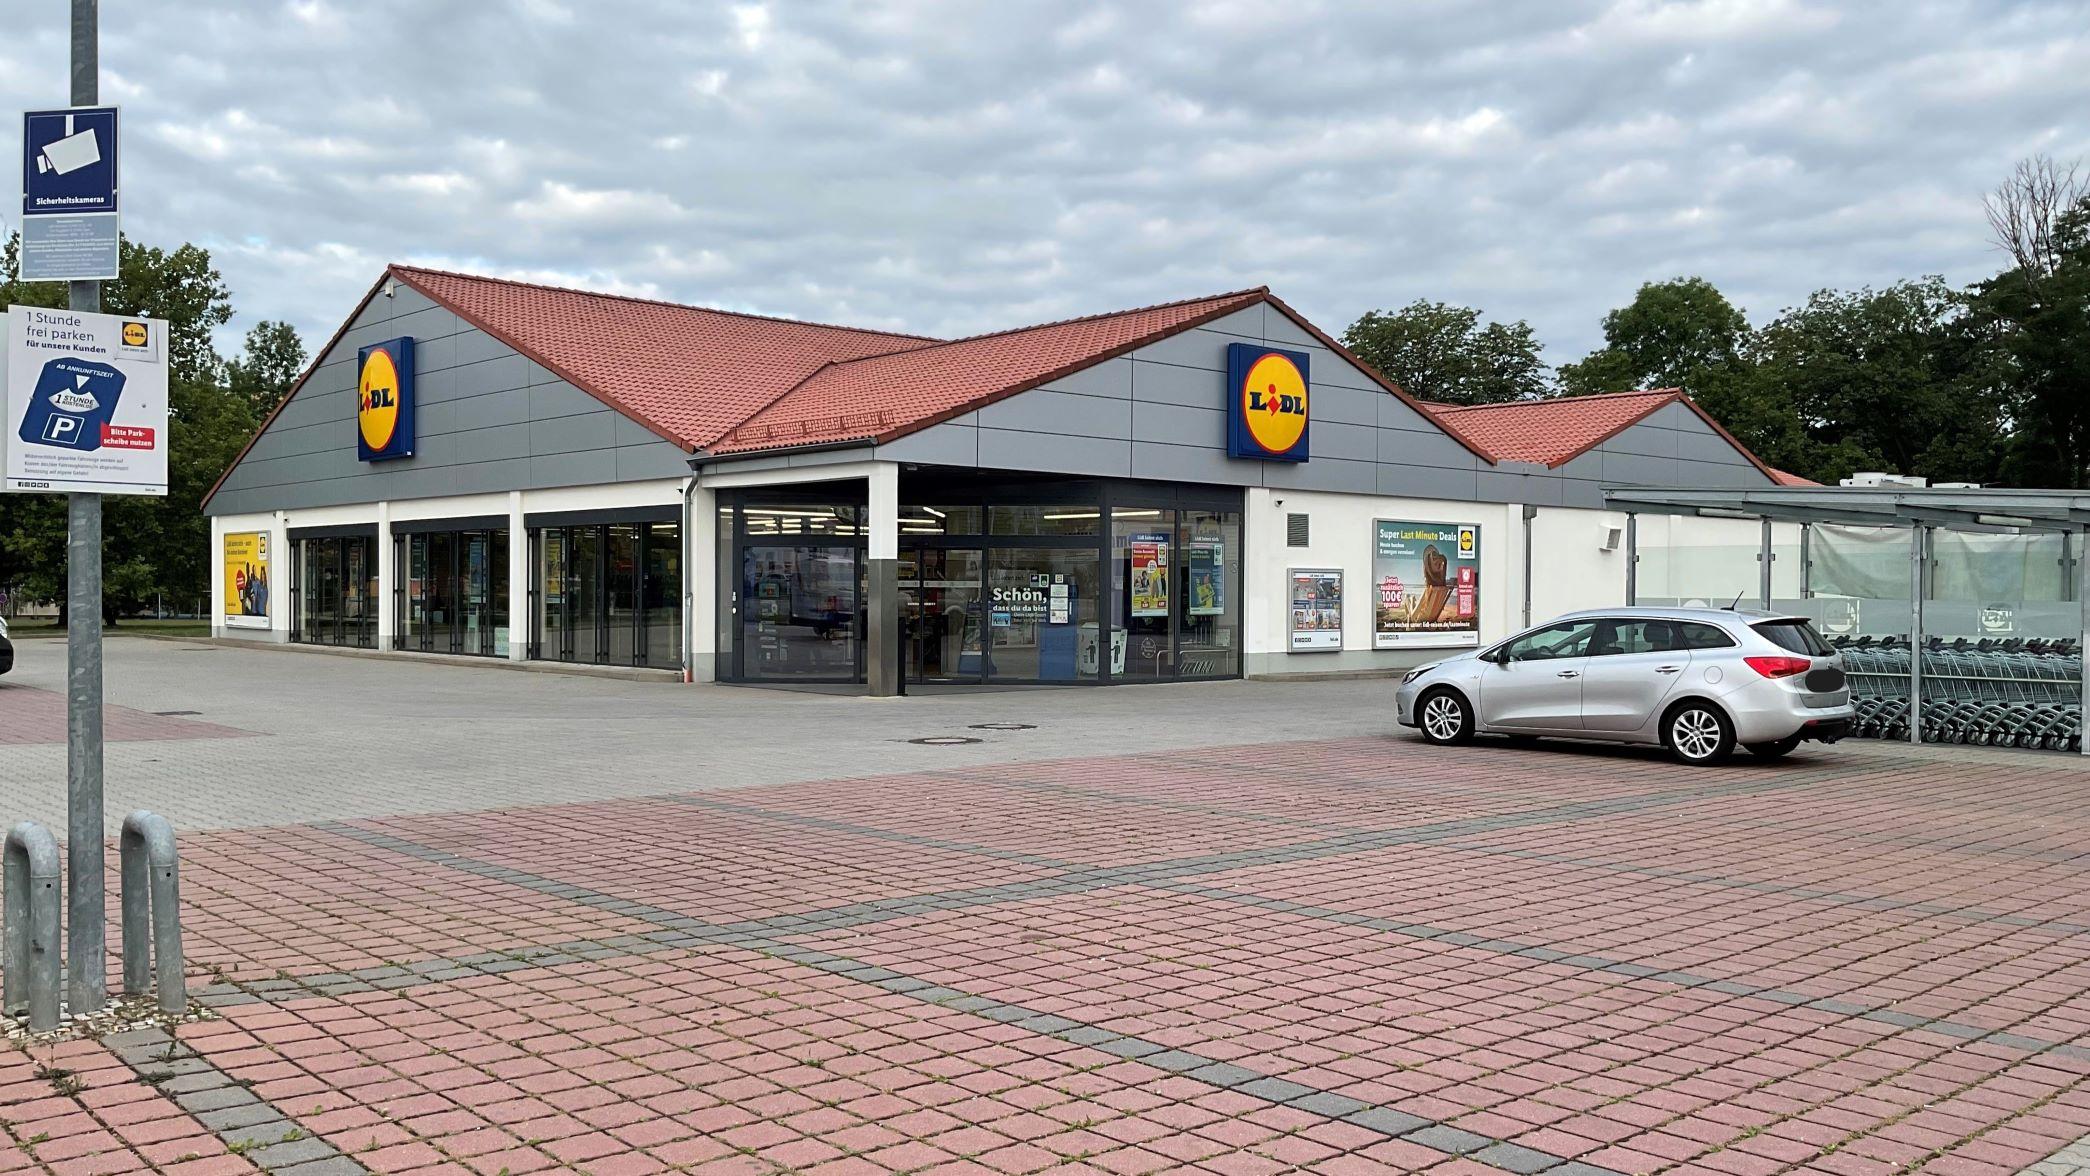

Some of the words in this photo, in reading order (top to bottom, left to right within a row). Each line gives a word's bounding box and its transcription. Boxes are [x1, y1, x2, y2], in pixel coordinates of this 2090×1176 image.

[36, 196, 105, 205] Sicherheitskameras
[26, 311, 32, 322] 1
[36, 312, 81, 327] Stunde
[26, 325, 47, 338] frei
[52, 328, 94, 342] parken
[26, 340, 40, 348] für
[41, 341, 71, 351] unsere
[73, 343, 106, 354] Kunden
[66, 365, 114, 378] ANKUNFTSZEIT
[55, 394, 62, 404] 1
[63, 395, 94, 406] STUNDE
[50, 417, 75, 439] P
[110, 428, 127, 436] Bitte
[127, 429, 145, 437] Park-
[103, 437, 129, 446] scheibe
[1380, 528, 1400, 541] Super
[1400, 530, 1415, 540] Last
[1415, 530, 1438, 541] Minute
[1439, 531, 1457, 541] Deals
[1385, 576, 1398, 584] Jetzt
[992, 587, 1047, 603] Schön,
[1381, 591, 1402, 602] 100€
